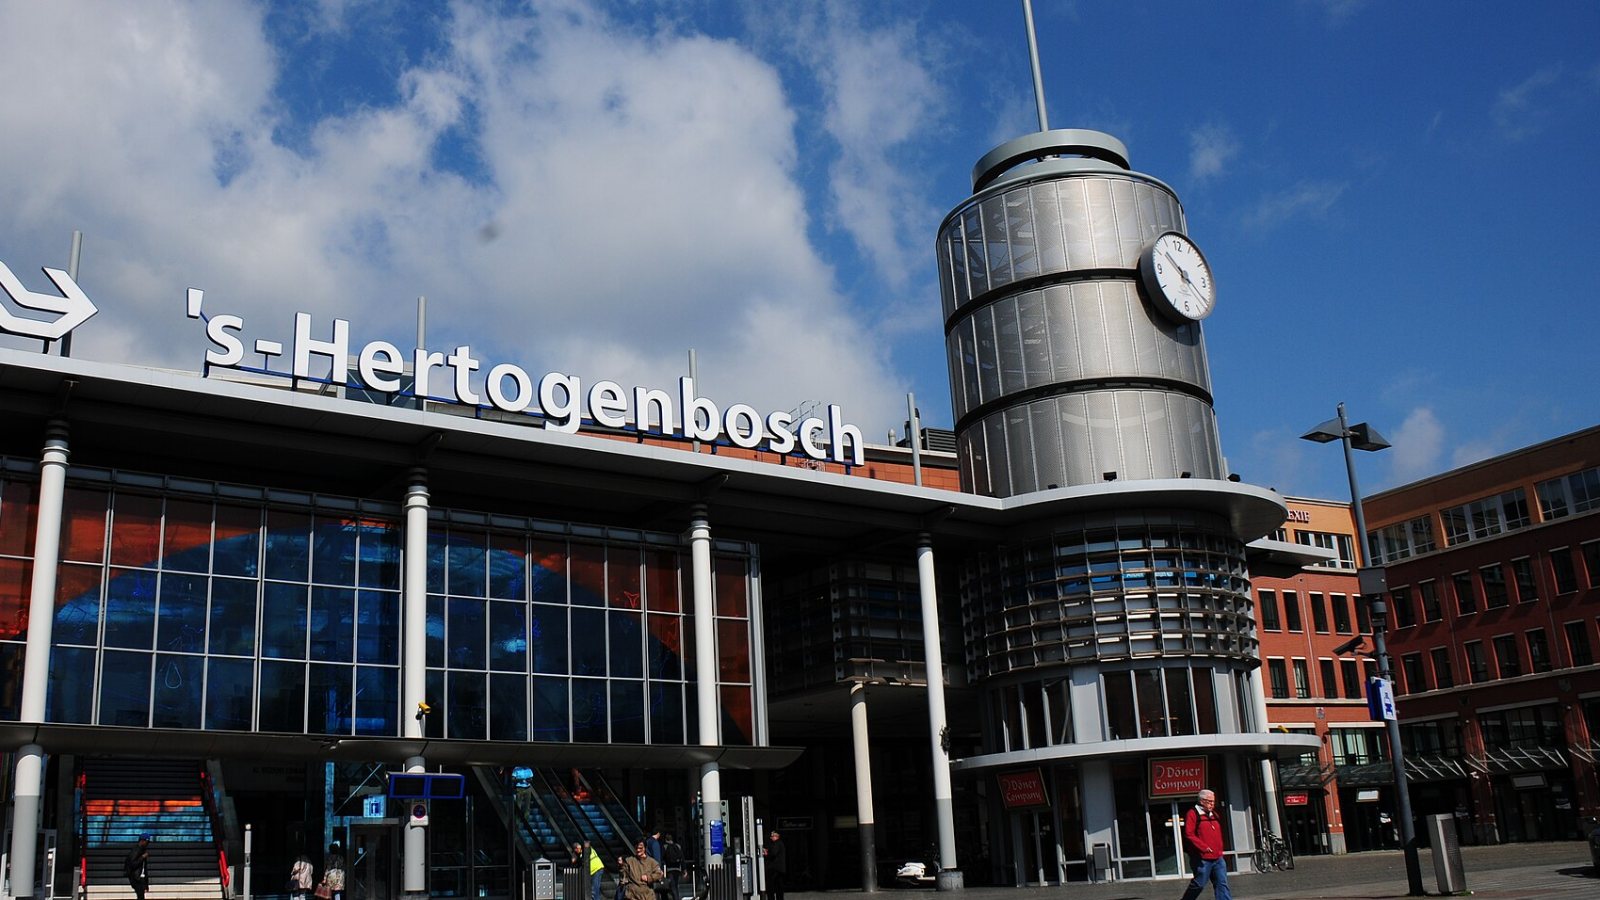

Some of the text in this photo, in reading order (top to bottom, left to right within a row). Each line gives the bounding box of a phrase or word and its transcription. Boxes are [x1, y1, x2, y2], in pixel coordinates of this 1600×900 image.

[1172, 240, 1182, 252] 12
[1156, 263, 1163, 275] 9
[1201, 277, 1207, 289] 3
[1184, 300, 1190, 312] 6
[187, 287, 865, 467] 's-Hertogenbosch
[1166, 766, 1201, 778] Döner
[1154, 779, 1201, 791] Company
[1006, 792, 1042, 802] Company
